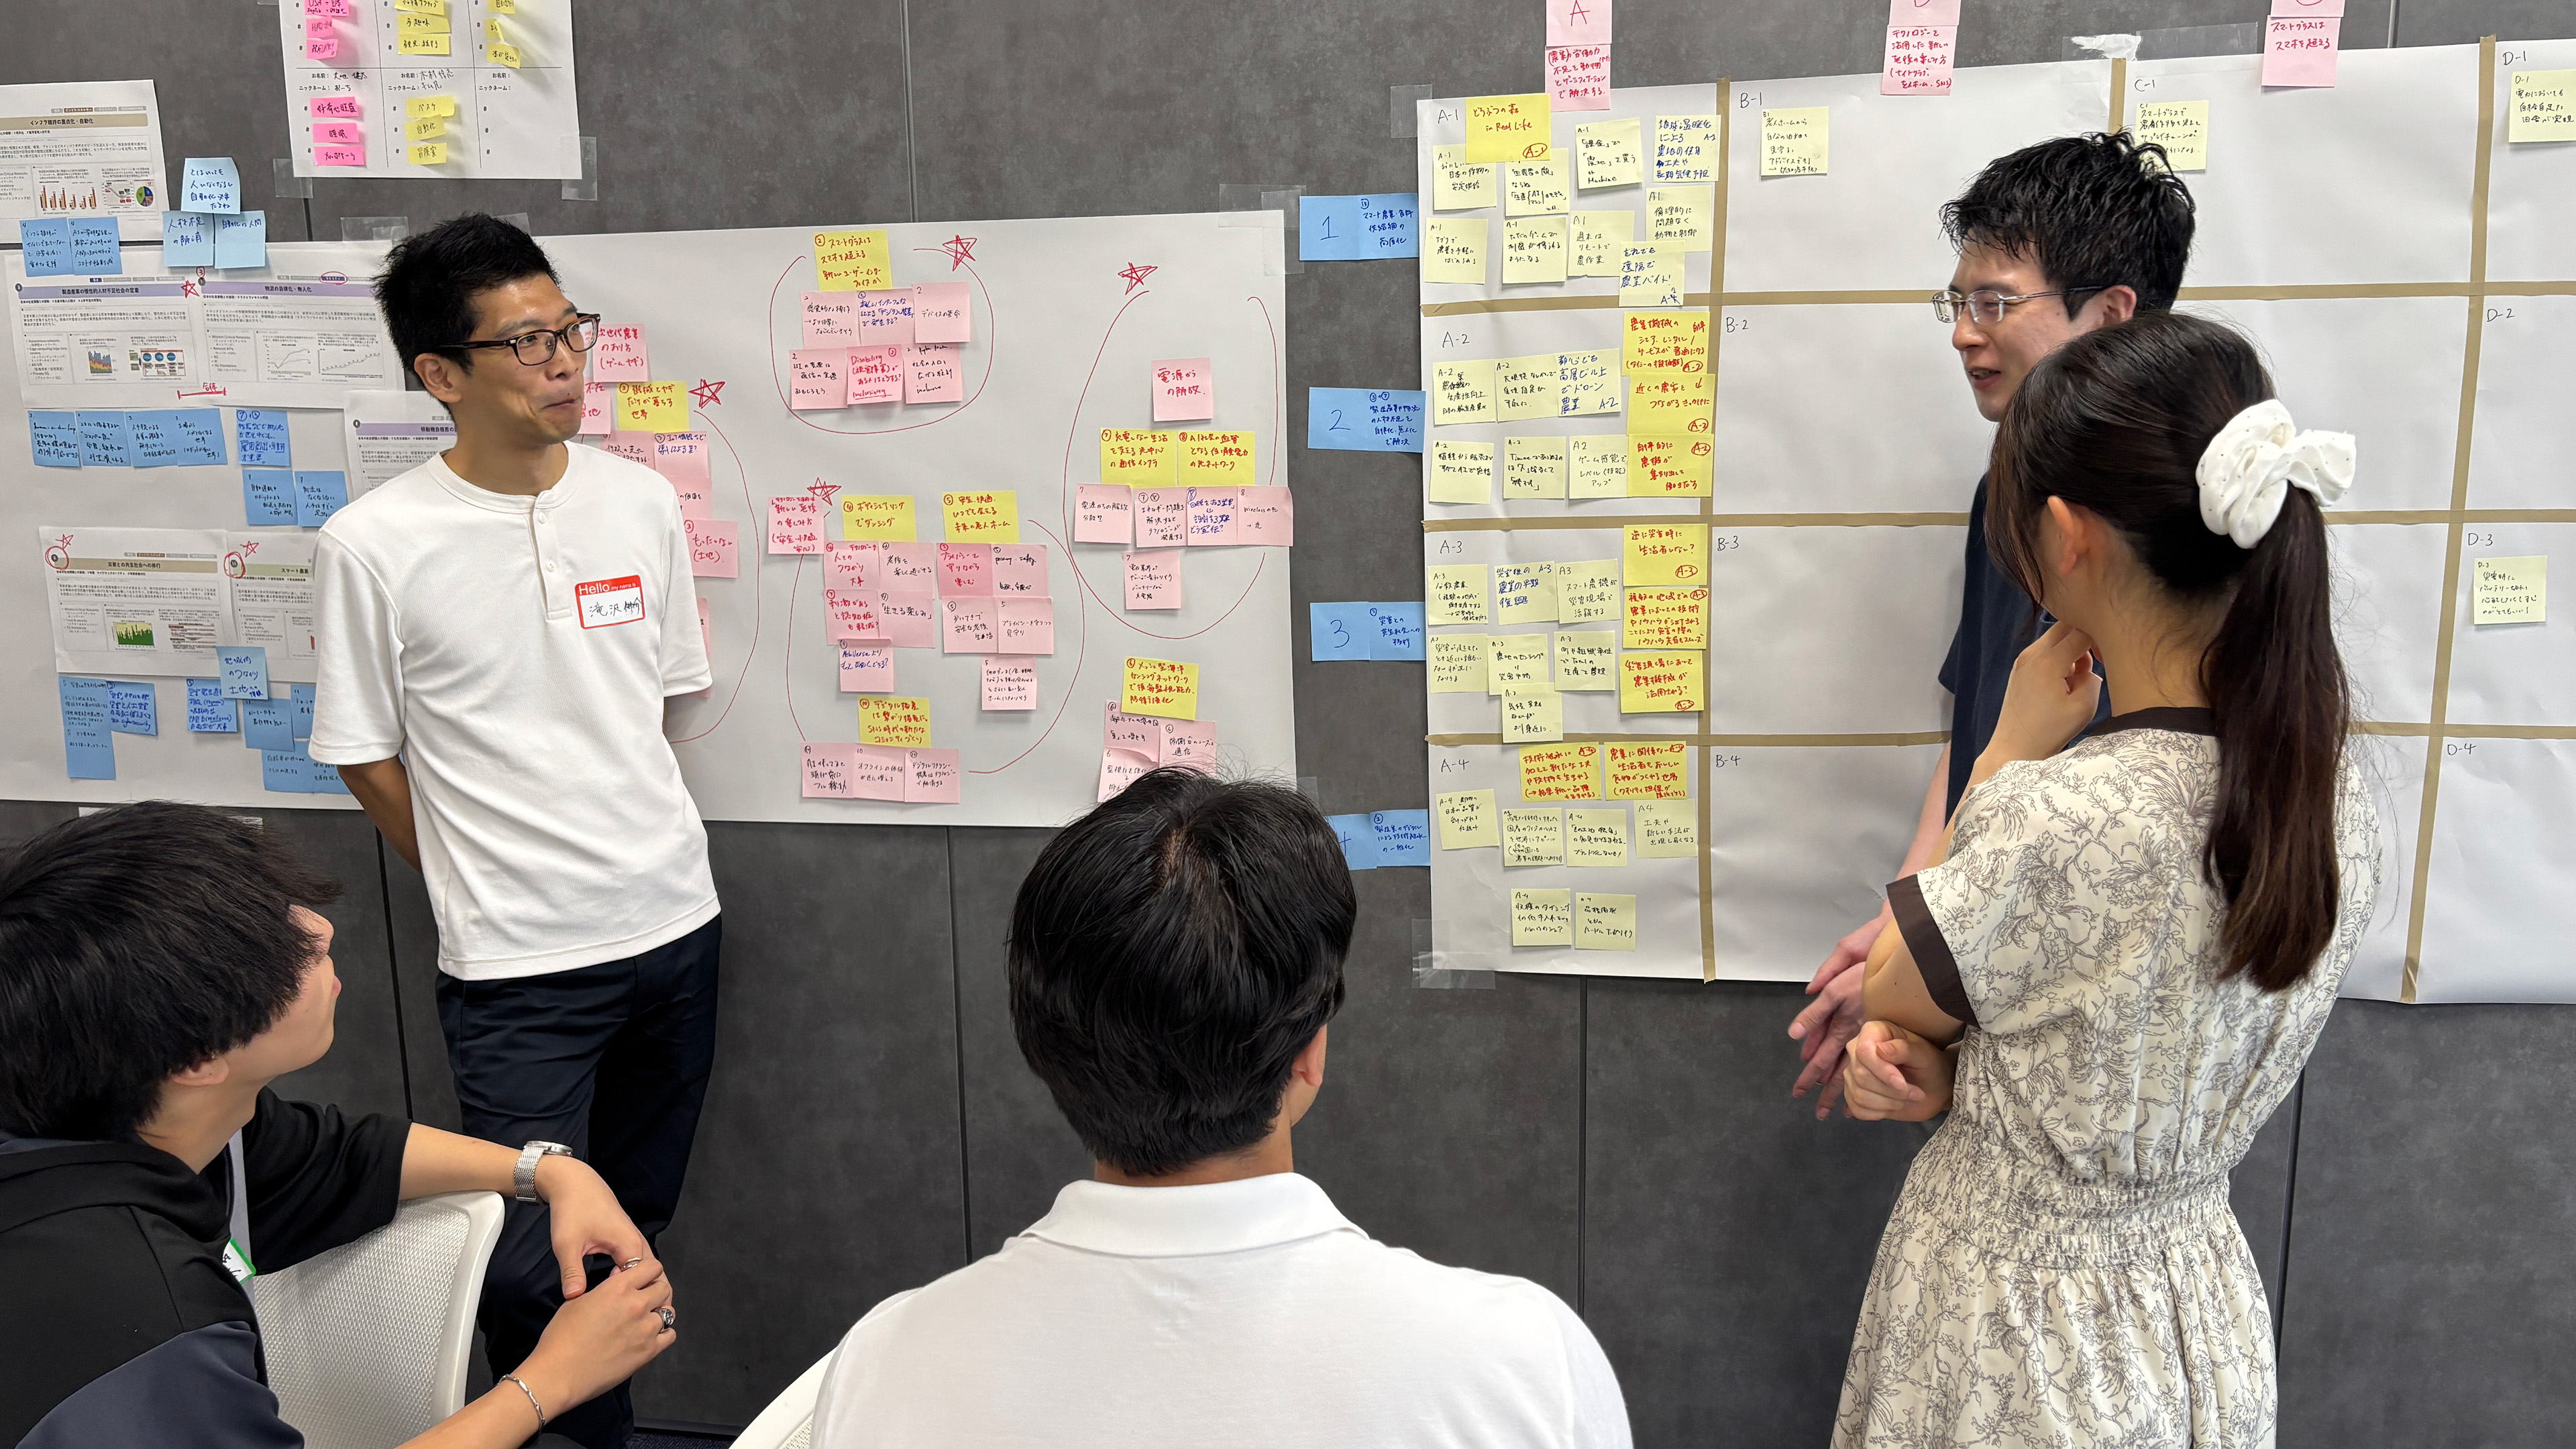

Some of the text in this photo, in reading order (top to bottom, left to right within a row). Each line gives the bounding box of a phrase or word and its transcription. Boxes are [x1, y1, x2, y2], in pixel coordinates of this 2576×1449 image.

[1570, 0, 1590, 26] A
[2503, 51, 2526, 66] D-1
[2135, 79, 2155, 93] C-1
[1740, 92, 1762, 108] B-1
[1438, 109, 1458, 123] A-1
[1496, 123, 1511, 131] Real
[1515, 119, 1532, 131] Life
[1320, 216, 1339, 240] 1
[2487, 308, 2515, 323] D-2
[1726, 317, 1748, 333] B-2
[1442, 331, 1469, 348] A-2
[1329, 409, 1351, 431] 2
[1440, 539, 1462, 554] A-3
[1717, 535, 1739, 551] B-3
[2468, 533, 2493, 546] D-3
[580, 583, 610, 595] Hello
[1330, 619, 1350, 648] 3
[2448, 743, 2476, 756] D-4
[1441, 759, 1469, 773] A-4
[1716, 755, 1740, 768] B-4
